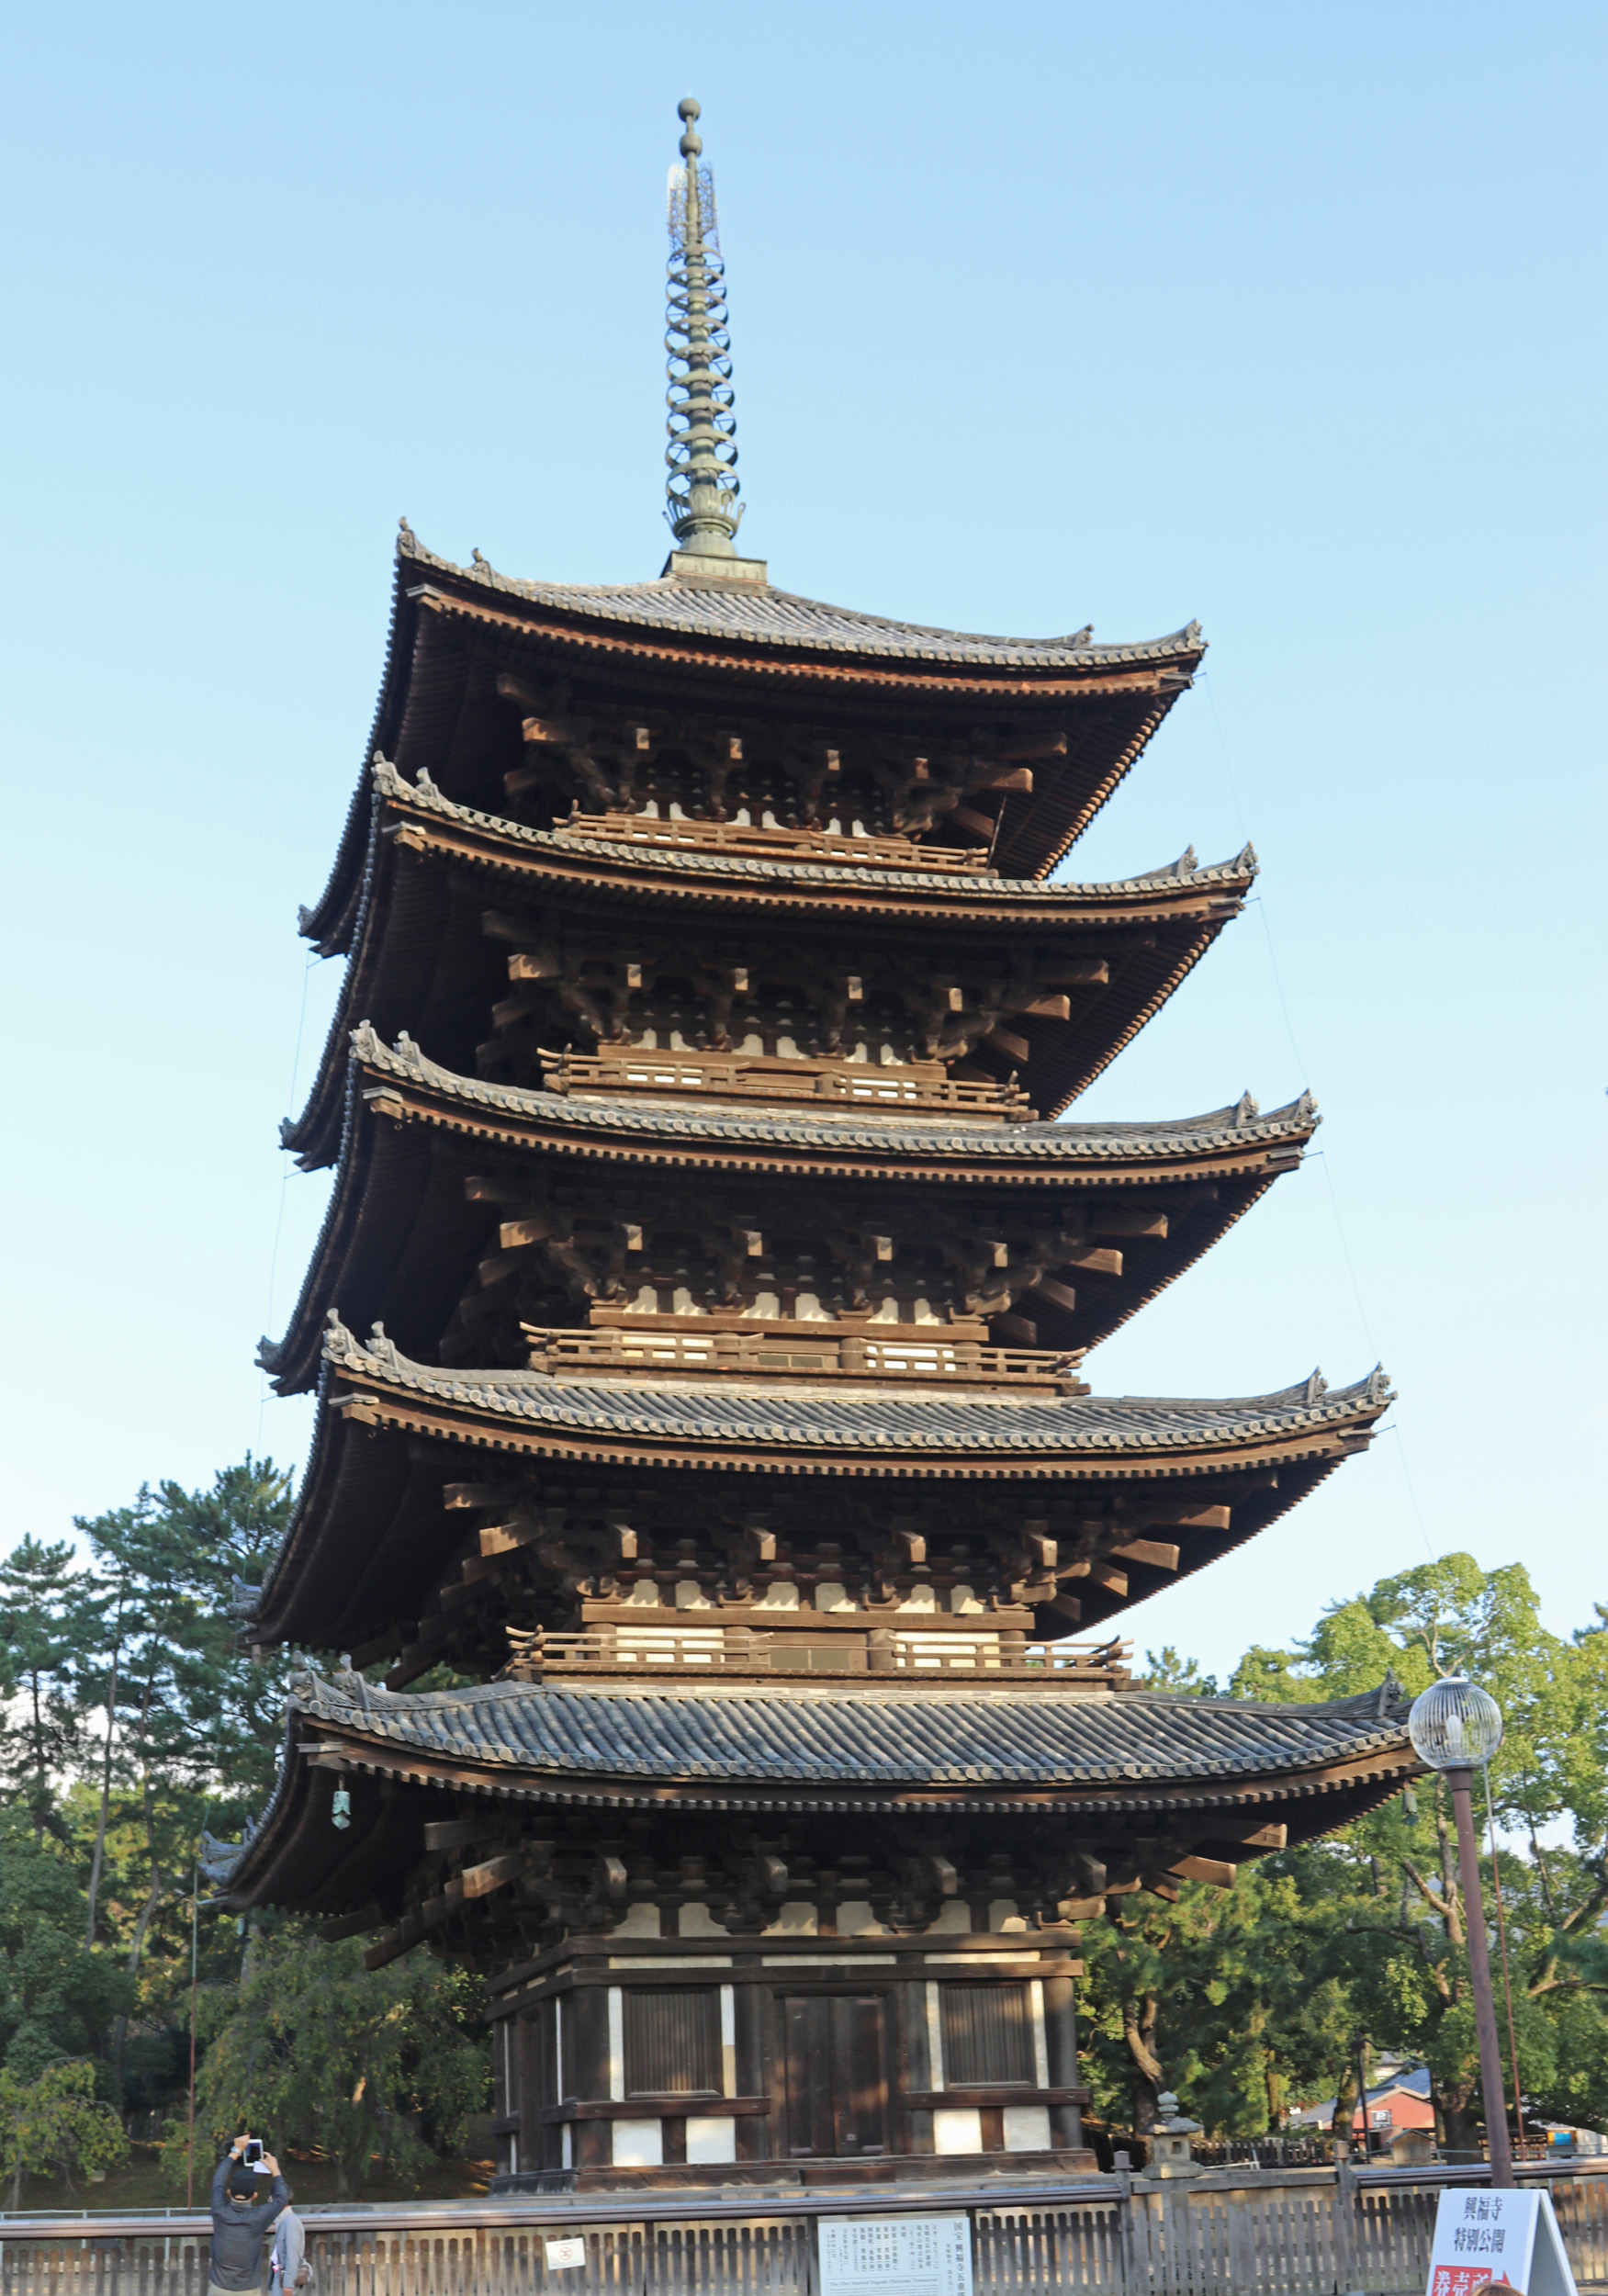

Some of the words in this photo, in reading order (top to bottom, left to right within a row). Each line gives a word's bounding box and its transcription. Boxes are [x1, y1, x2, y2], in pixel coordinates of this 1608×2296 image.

[1463, 2196, 1503, 2222] 興福寺
[1454, 2227, 1506, 2253] 特別公開
